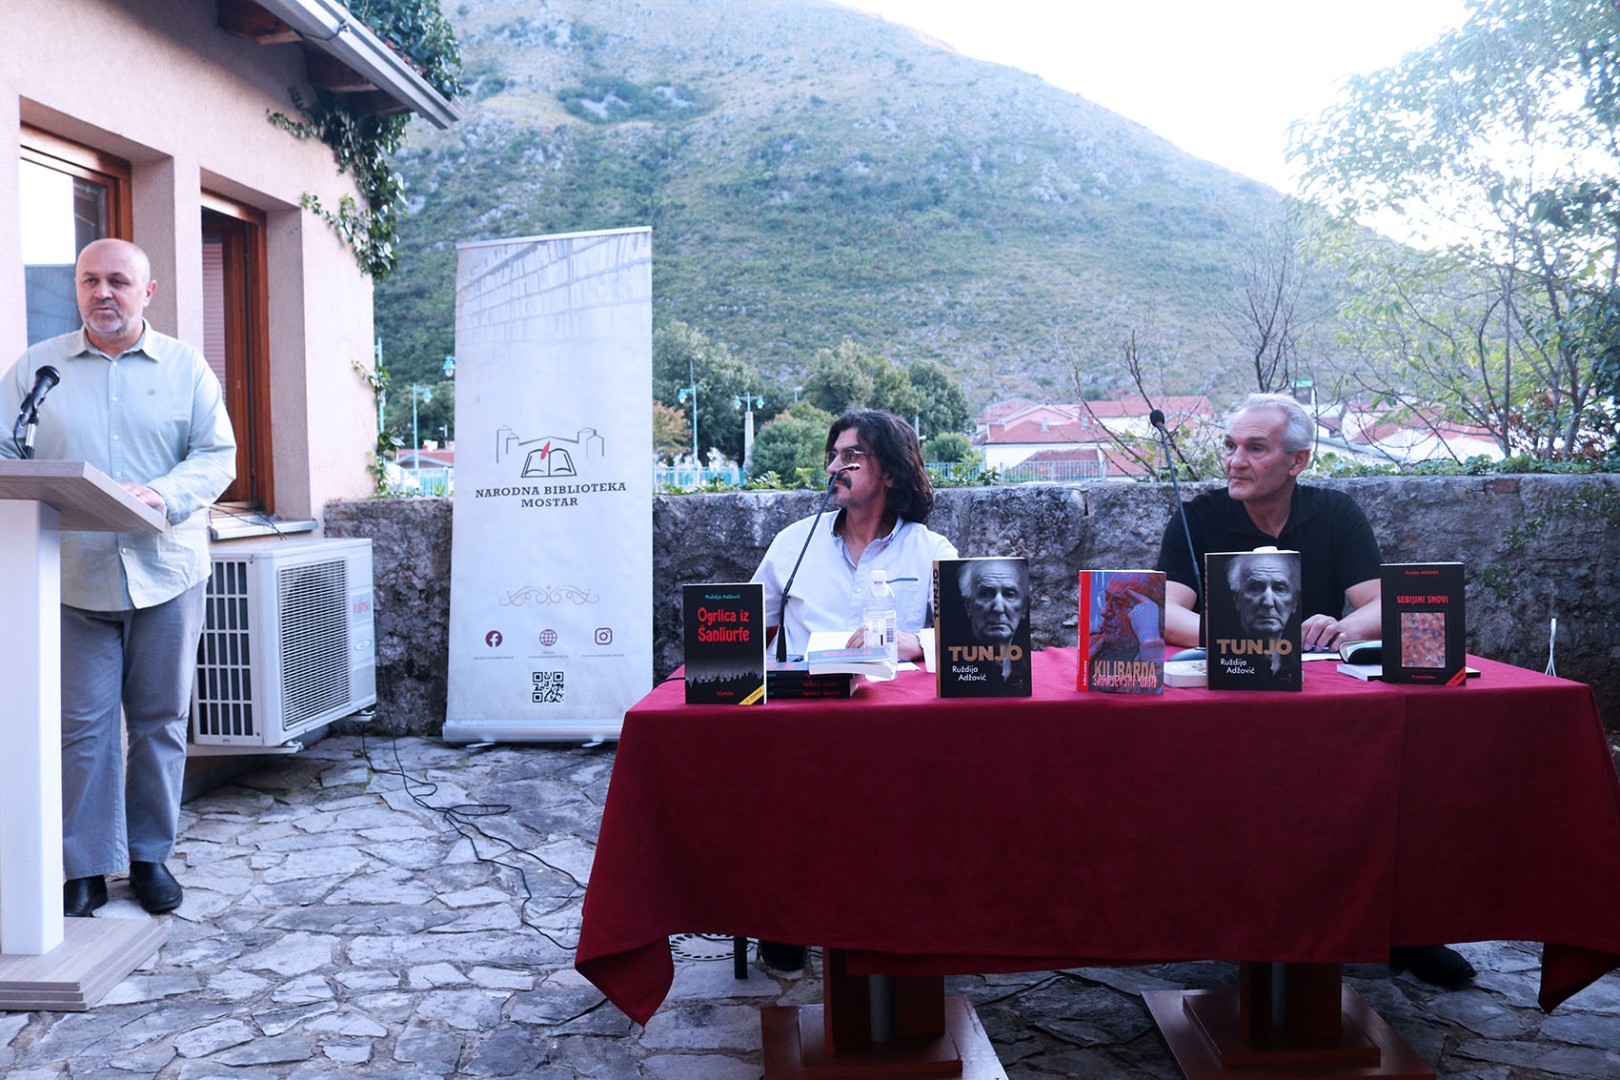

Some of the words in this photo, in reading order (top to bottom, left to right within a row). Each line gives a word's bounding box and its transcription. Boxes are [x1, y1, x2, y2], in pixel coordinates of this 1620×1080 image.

[475, 486, 540, 498] NARODNA
[544, 482, 627, 495] BIBLIOTEKA
[521, 497, 579, 508] MOSTAR
[1427, 595, 1449, 604] SNOVI
[697, 607, 737, 626] Ogrlica
[740, 609, 750, 622] iz
[1216, 639, 1293, 656] TUNJO
[948, 645, 1023, 662] TUNJO
[1220, 658, 1247, 668] Ruždija
[952, 665, 979, 675] Ruždija
[1094, 660, 1157, 681] KILIBARDA
[1226, 666, 1255, 675] Adžović
[958, 673, 987, 682] Adžović
